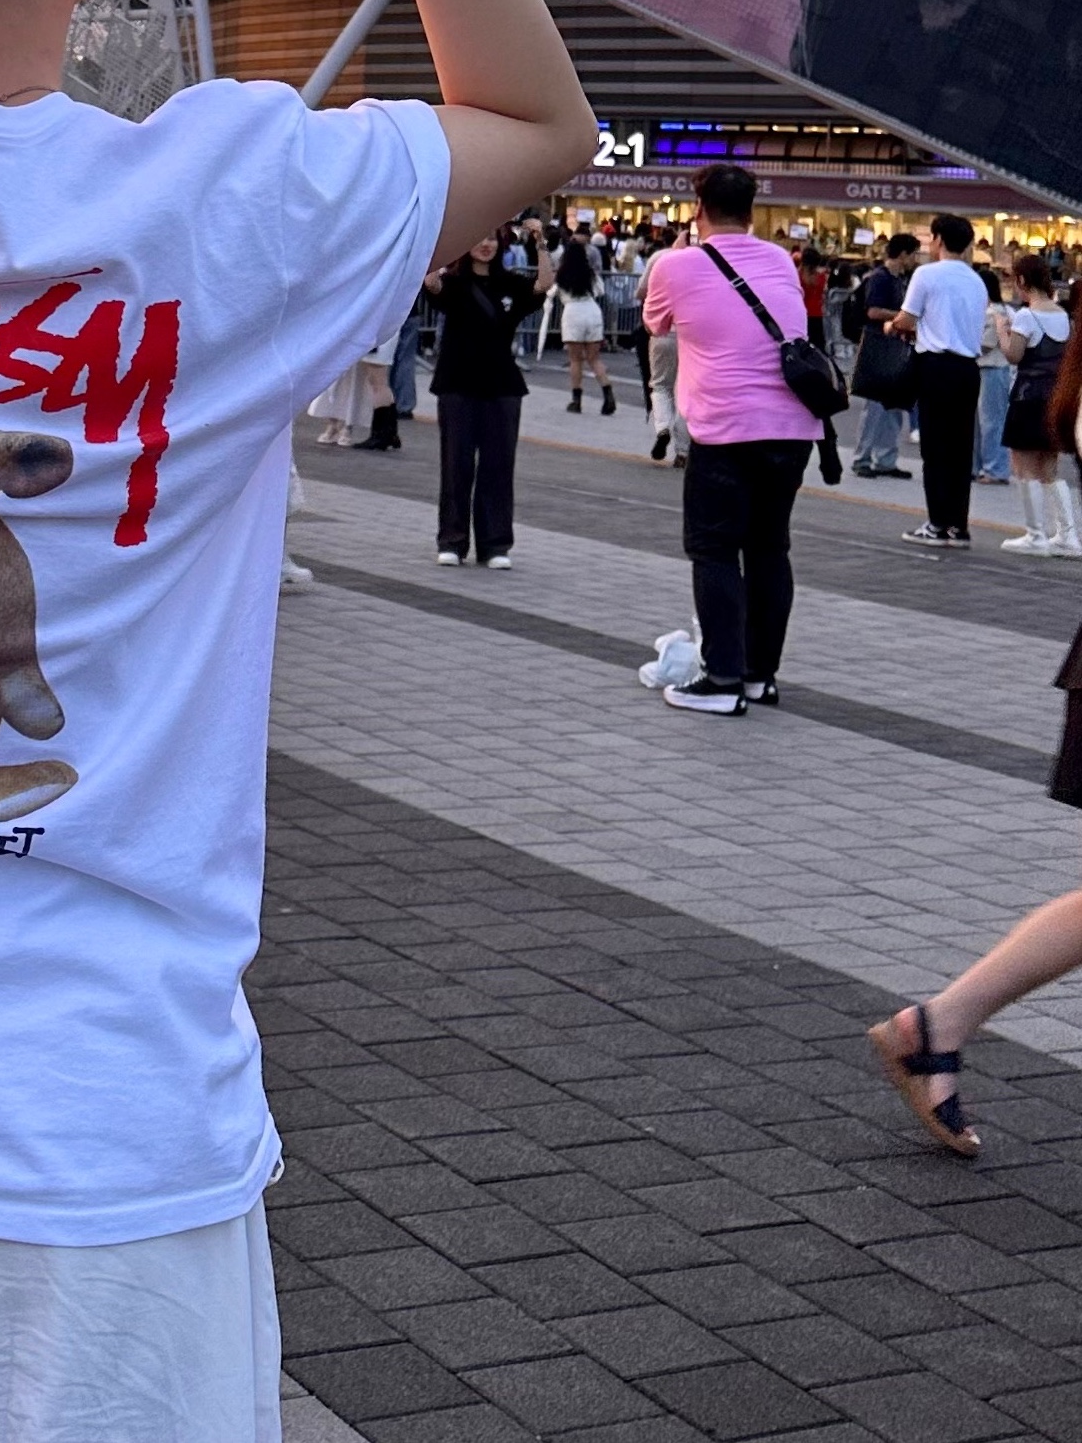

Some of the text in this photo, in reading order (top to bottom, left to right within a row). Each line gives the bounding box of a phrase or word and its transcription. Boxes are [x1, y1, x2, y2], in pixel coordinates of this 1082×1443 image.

[593, 131, 645, 168] 2-1
[587, 174, 658, 190] STANDING
[846, 183, 921, 200] GATE 2-1
